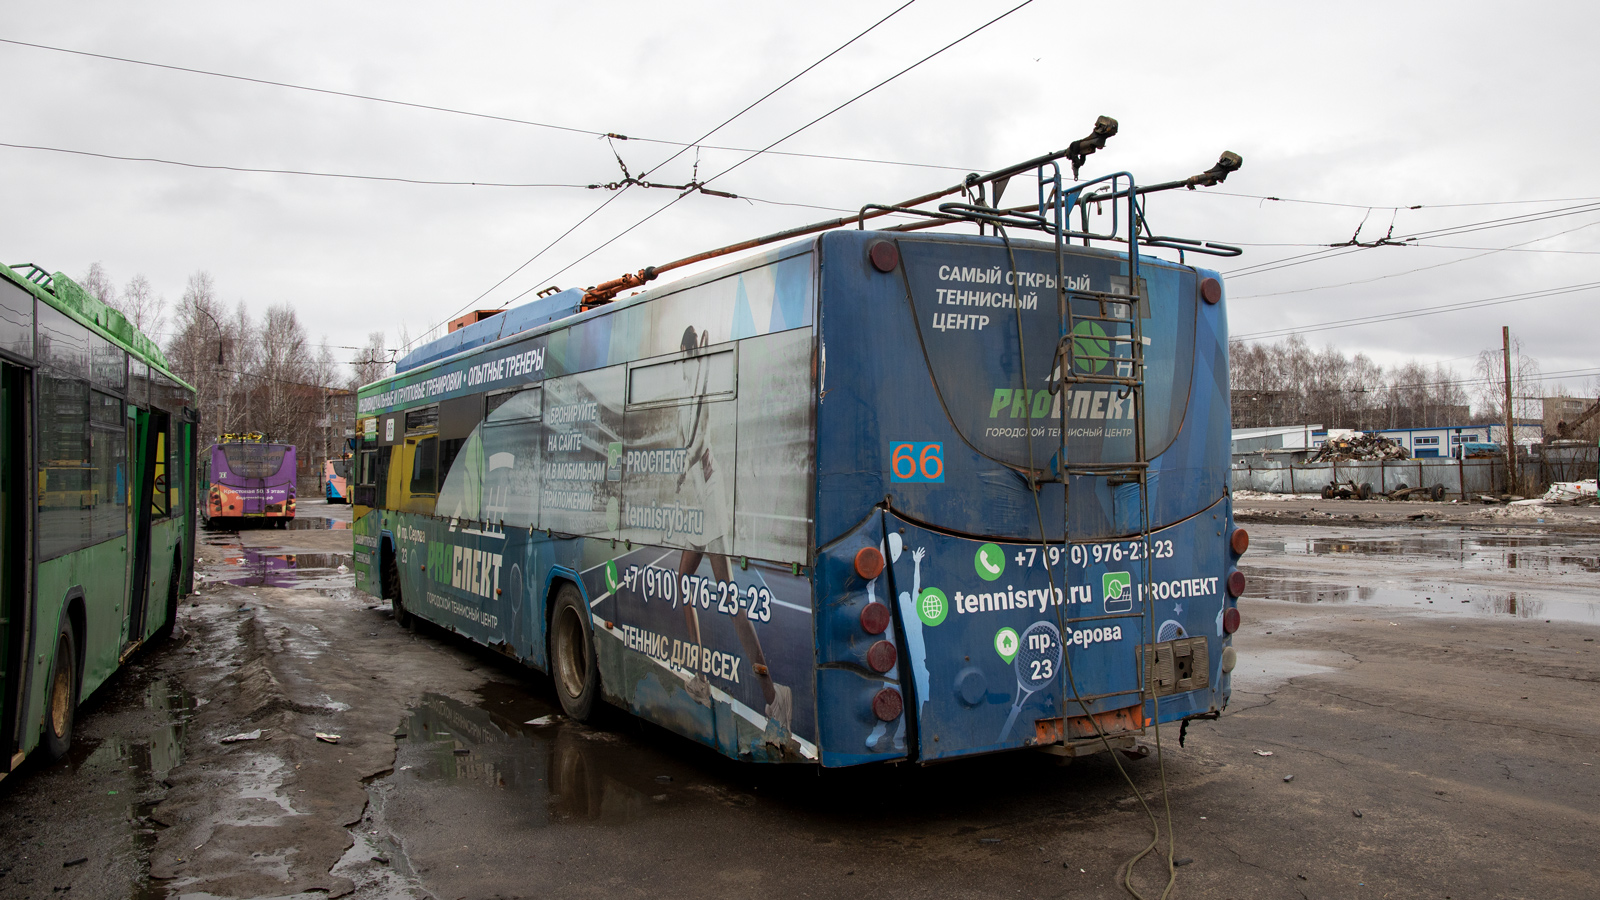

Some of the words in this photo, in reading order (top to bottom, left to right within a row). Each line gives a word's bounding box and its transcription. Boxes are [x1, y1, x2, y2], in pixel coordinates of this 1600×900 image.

[938, 264, 1002, 284] САМЫЙ
[1005, 270, 1091, 291] ОТКРЫЫЙ
[936, 288, 1038, 310] ТЕННИСНЫЙ
[932, 312, 990, 332] ЦЕНТР
[425, 371, 463, 399] ТРЕНИРОВКИ
[468, 361, 504, 386] ОПЫТНЫЕ
[505, 346, 546, 379] ТРЕНЕРЫ
[550, 400, 598, 425] БРОНИРУЙТЕ
[547, 435, 557, 451] НА
[558, 432, 582, 451] САЙТЕ
[1104, 428, 1132, 438] ЦЕНТР
[557, 462, 605, 481] МОБИЛЬНОМ
[891, 444, 944, 480] 66
[544, 490, 593, 511] ПРИЛОЖЕНИИ
[624, 501, 703, 538] tennisryb.ru
[1014, 548, 1037, 567] +7
[1042, 544, 1088, 571] (90)
[1092, 540, 1174, 563] 976-23-23
[623, 565, 638, 592] +7
[642, 564, 678, 609] (910)
[681, 575, 772, 622] 976-23-23
[451, 600, 479, 622] ТЕННИСНЫЙ
[480, 611, 498, 629] ЦЕНТР
[1028, 633, 1056, 654] пр.
[1062, 625, 1122, 648] Серова
[622, 624, 669, 660] ТЕННИС
[670, 639, 699, 669] ДЛЯ
[701, 647, 741, 683] ВСЕХ
[1030, 660, 1053, 680] 23
